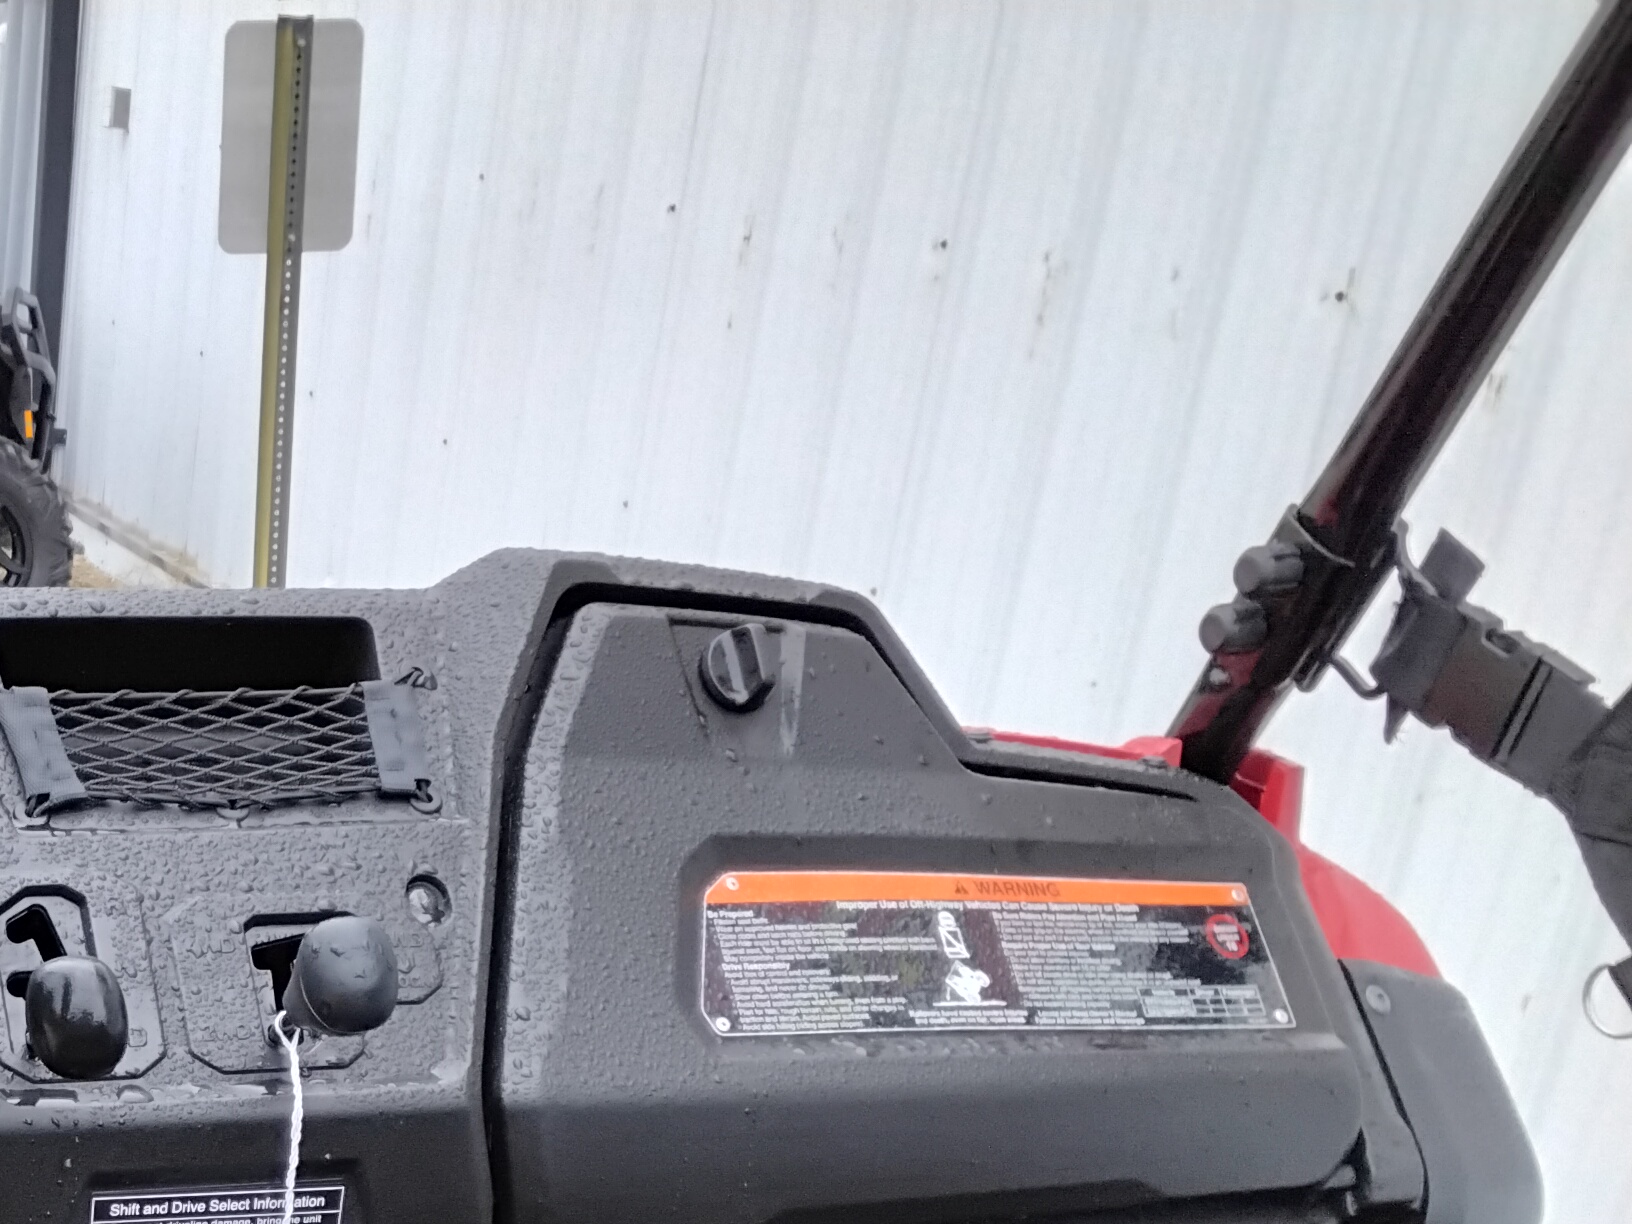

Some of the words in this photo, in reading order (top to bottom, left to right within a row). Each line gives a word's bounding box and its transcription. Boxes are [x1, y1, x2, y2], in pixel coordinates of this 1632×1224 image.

[974, 880, 1060, 898] WARNING
[109, 1203, 140, 1217] Shift
[143, 1202, 168, 1215] and
[172, 1200, 206, 1213] Drive
[209, 1198, 250, 1212] Select
[253, 1195, 325, 1210] Inforation
[303, 1214, 322, 1223] unit
